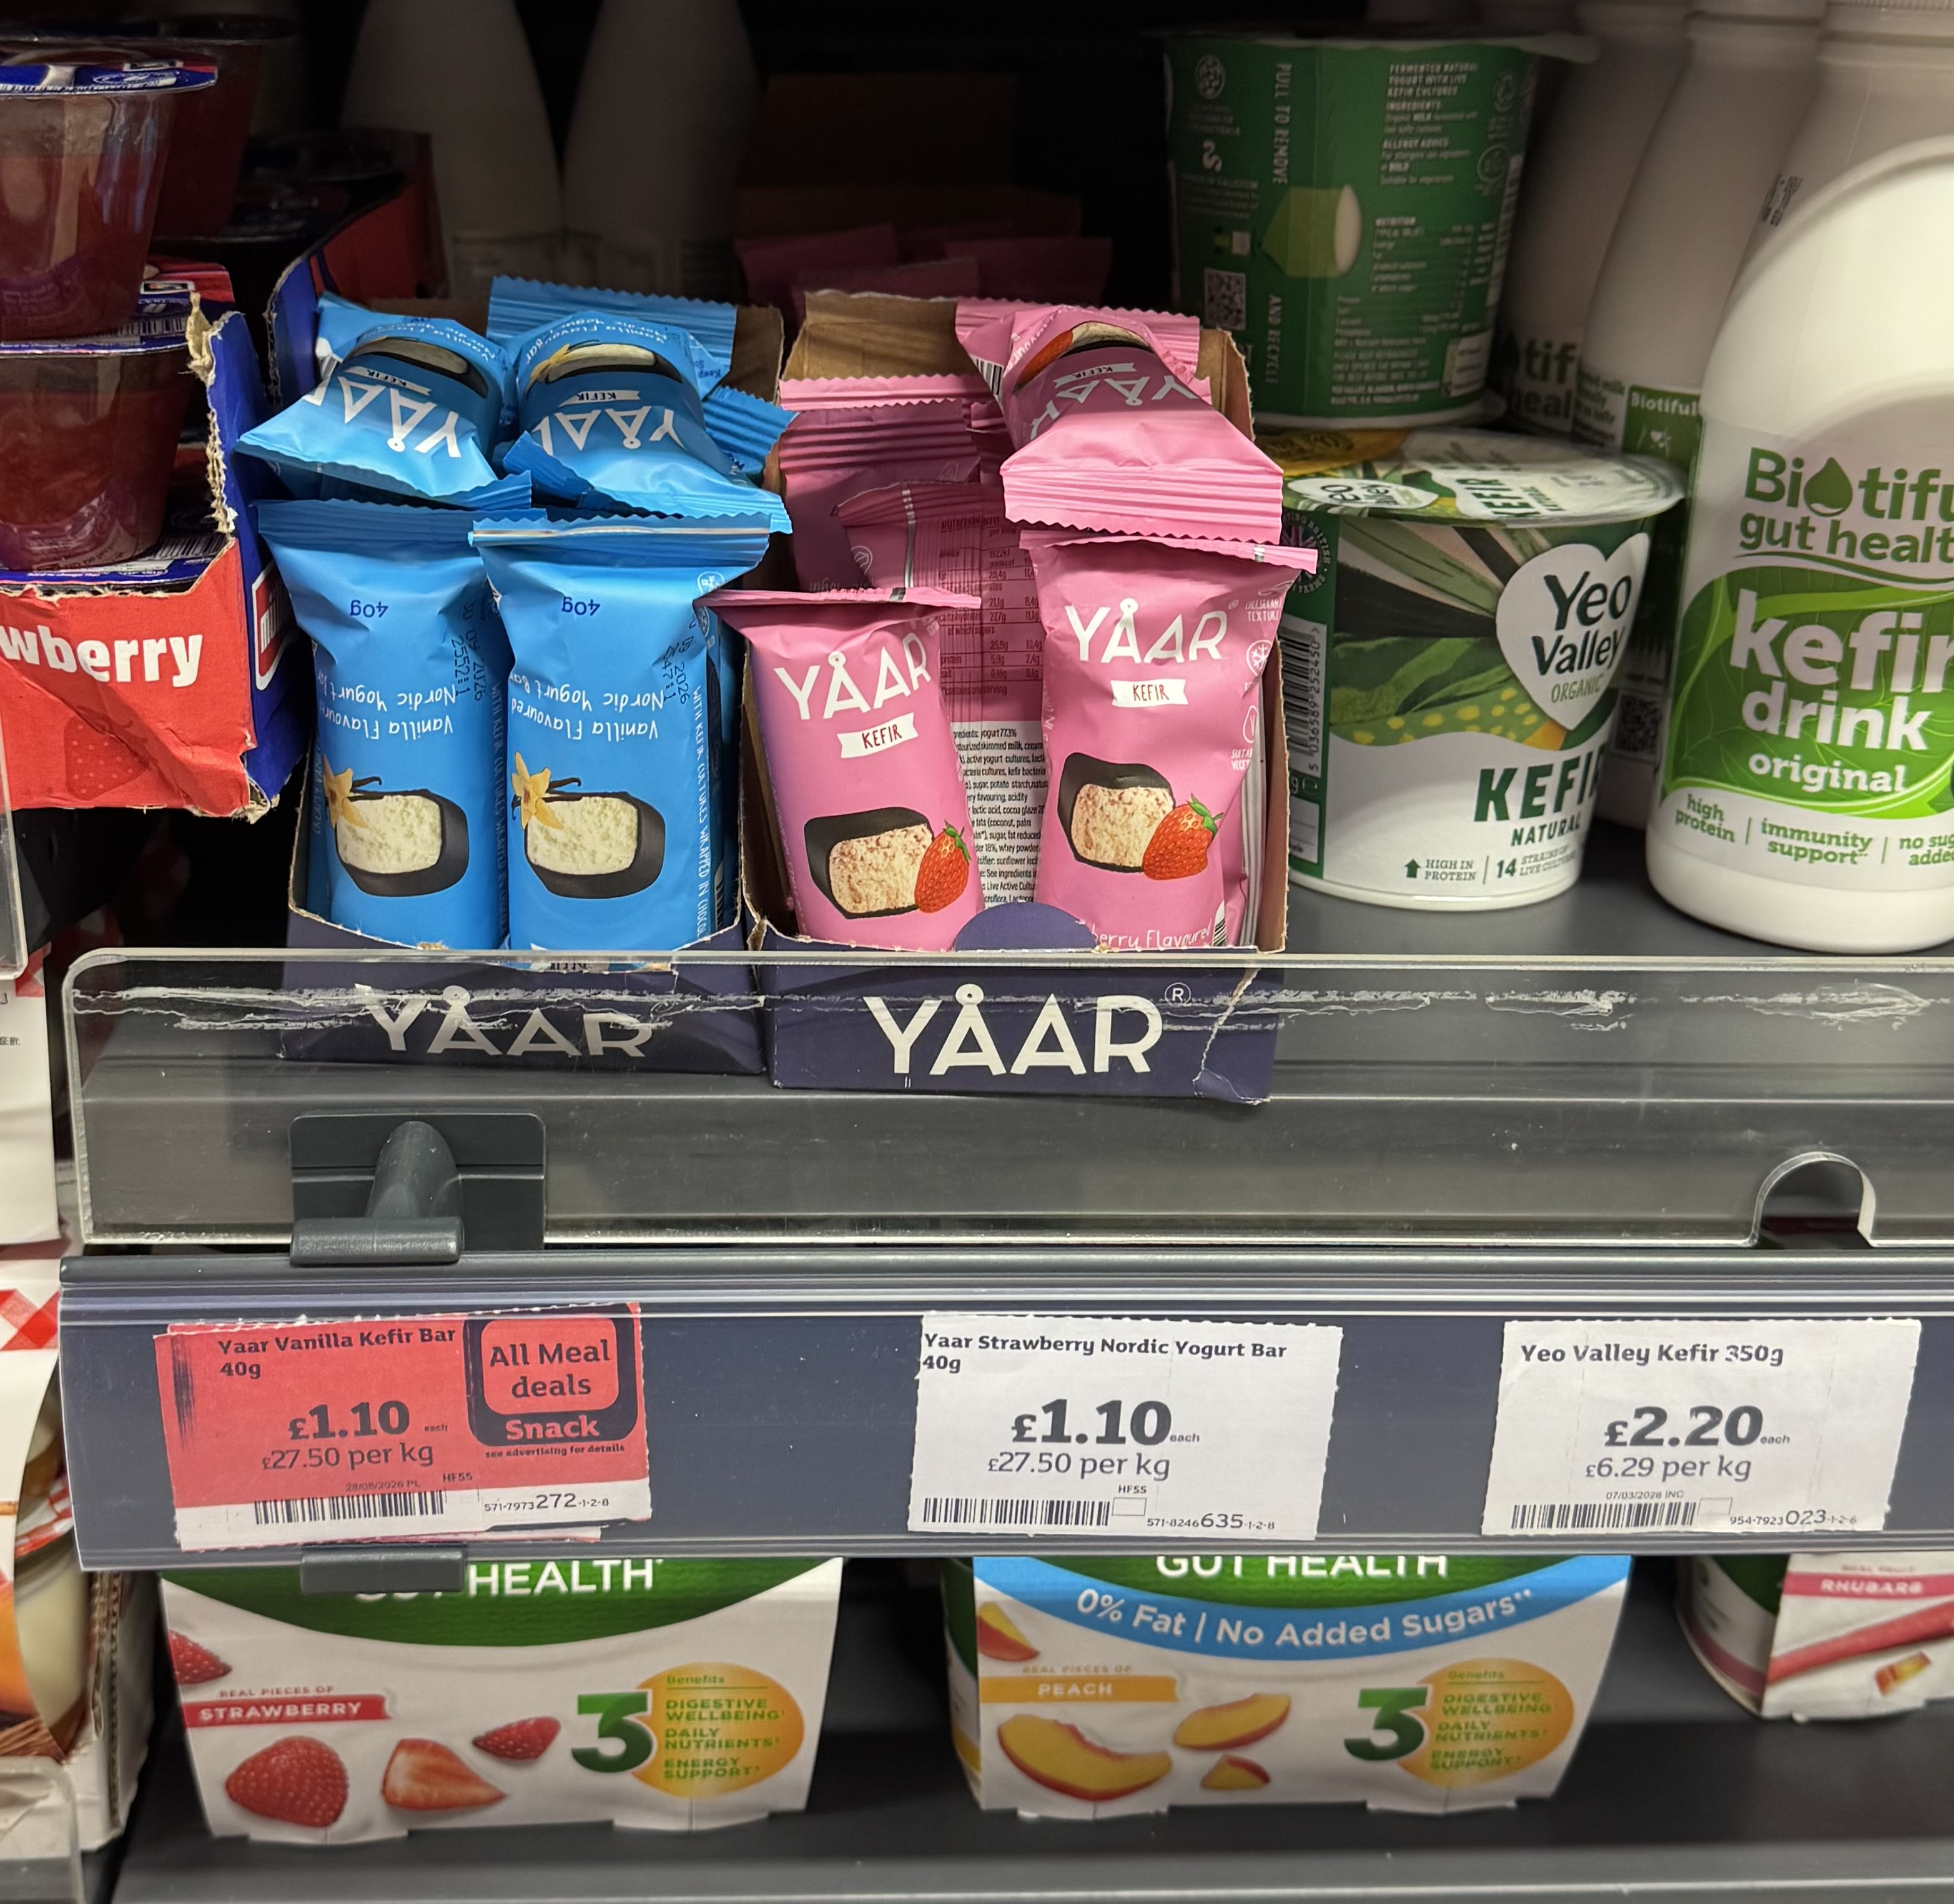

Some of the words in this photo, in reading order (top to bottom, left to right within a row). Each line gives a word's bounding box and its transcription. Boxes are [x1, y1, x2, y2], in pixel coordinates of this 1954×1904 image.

[1272, 129, 1290, 184] REMOVE
[1739, 512, 1816, 552] gut
[350, 599, 388, 618] 40g
[561, 596, 601, 616] 40g
[1543, 570, 1633, 632] Yeo
[1064, 598, 1228, 664] YÅAR
[1309, 641, 1321, 692] 252450
[1531, 629, 1622, 676] Valley
[774, 632, 931, 720] YÅAR
[1551, 674, 1604, 704] ORGANIC
[329, 681, 388, 713] Yogurt
[397, 683, 456, 711] Nordic
[534, 679, 593, 712] Yogurt
[603, 689, 665, 713] Nordic
[692, 685, 703, 721] WITH
[1132, 683, 1170, 702] KEFIR
[389, 714, 454, 741] Vanilla
[511, 698, 582, 740] Flavoured
[591, 719, 658, 742] Vanilla
[1742, 681, 1933, 751] drink
[861, 723, 903, 751] KEFIR
[983, 755, 1003, 765] yogurt
[1748, 753, 1906, 794] original
[697, 762, 708, 824] CULTURES
[1686, 794, 1724, 822] high
[1511, 812, 1581, 847] NATURAL
[1675, 809, 1735, 844] protein
[1760, 817, 1873, 852] immunity
[698, 825, 711, 878] WRAPPED
[1899, 837, 1925, 850] no
[1424, 871, 1476, 882] PROTEIN
[1426, 859, 1458, 871] HIGH
[1459, 859, 1474, 870] IN
[1496, 857, 1517, 879] 14
[698, 881, 709, 897] IN
[1146, 918, 1213, 950] Flavoured
[355, 984, 654, 1058] YÅAR
[862, 984, 1164, 1075] YÅAR
[217, 1339, 269, 1354] Yaar
[275, 1333, 353, 1352] Vanilla
[359, 1328, 413, 1347] Kefir
[419, 1328, 456, 1343] Bar
[489, 1343, 530, 1367] All
[538, 1339, 610, 1365] Meal
[924, 1333, 973, 1348] Yaar
[977, 1335, 1095, 1356] Strawberry
[1100, 1338, 1169, 1354] Nordic
[1175, 1340, 1245, 1359] Yogurt
[1251, 1343, 1288, 1358] Bar
[1521, 1344, 1566, 1363] Yeo
[1572, 1343, 1651, 1366] Valley
[1657, 1343, 1719, 1363] Kefir
[1725, 1344, 1784, 1367] 350g
[220, 1361, 261, 1379] 40g
[922, 1355, 962, 1374] 40g
[511, 1374, 591, 1399] deals
[289, 1400, 410, 1441] £1.10
[424, 1423, 448, 1433] each
[505, 1415, 600, 1441] Snack
[1010, 1398, 1172, 1446] £1.10
[1170, 1433, 1200, 1443] each
[1604, 1405, 1764, 1447] £2.20
[1760, 1435, 1790, 1445] each
[262, 1446, 340, 1470] £27.50
[348, 1448, 393, 1471] per
[401, 1443, 434, 1467] kg
[505, 1445, 567, 1458] advertising
[569, 1444, 585, 1454] for
[587, 1444, 625, 1454] details
[987, 1451, 1072, 1473] £27.50
[1079, 1457, 1128, 1479] per
[1135, 1453, 1170, 1482] kg
[1585, 1457, 1654, 1478] £6.29
[1661, 1460, 1711, 1482] per
[1717, 1455, 1752, 1482] kg
[1118, 1485, 1147, 1494] HFSS
[1820, 1578, 1924, 1596] RHUBARB
[1077, 1588, 1125, 1622] 0%
[1132, 1604, 1187, 1636] Fat
[1216, 1619, 1264, 1645] No
[1276, 1619, 1391, 1647] Added
[220, 1688, 256, 1698] REAL
[261, 1687, 311, 1696] PIECES
[316, 1685, 334, 1695] OF
[666, 1675, 725, 1685] Benefits
[1037, 1684, 1113, 1697] PEACH
[199, 1702, 362, 1722] STRAWBERRY
[665, 1699, 767, 1710] DIGESTIVE
[1443, 1694, 1542, 1704] DIGESTIVE
[571, 1691, 654, 1773] 3
[664, 1727, 720, 1739] DAILY
[1343, 1687, 1429, 1762] 3
[1438, 1720, 1491, 1732] DAILY
[663, 1757, 741, 1768] ENERGY
[1431, 1749, 1505, 1761] ENERGY
